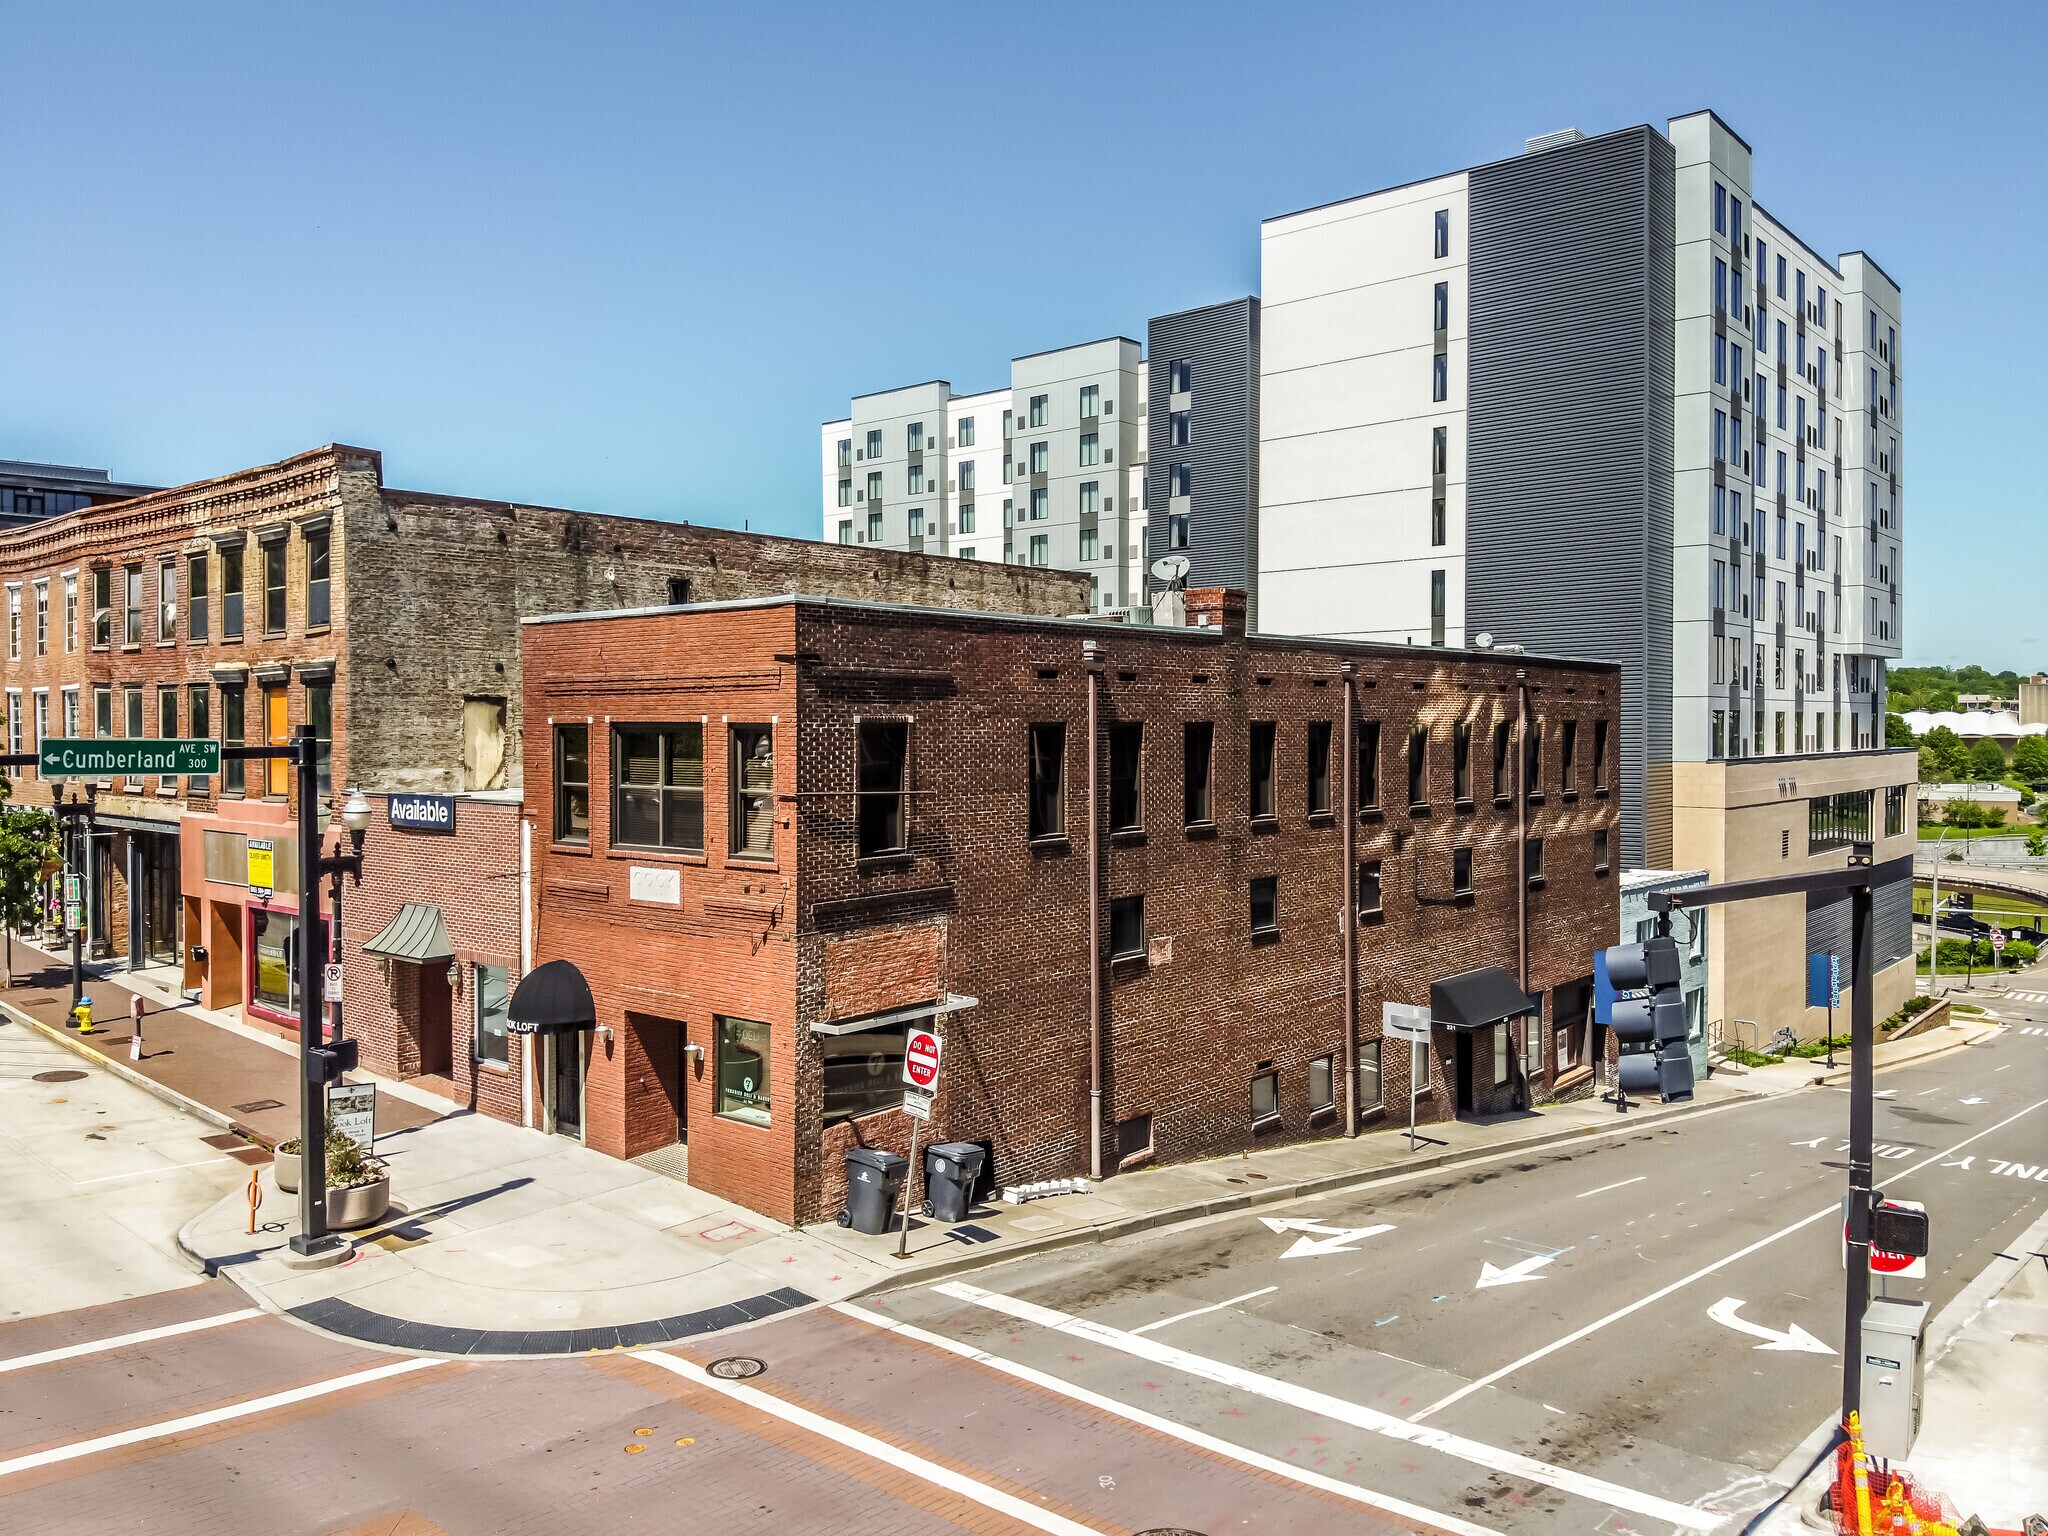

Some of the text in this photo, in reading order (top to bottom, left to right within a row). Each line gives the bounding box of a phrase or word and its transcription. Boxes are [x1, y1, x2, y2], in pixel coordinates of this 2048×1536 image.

[63, 744, 217, 768] Cumberland AVE SW
[188, 759, 207, 769] 300
[391, 798, 448, 823] Available
[517, 1021, 539, 1032] LOFT
[913, 1041, 936, 1054] DO NOT
[912, 1065, 931, 1077] ENTER
[354, 1116, 371, 1126] Loft
